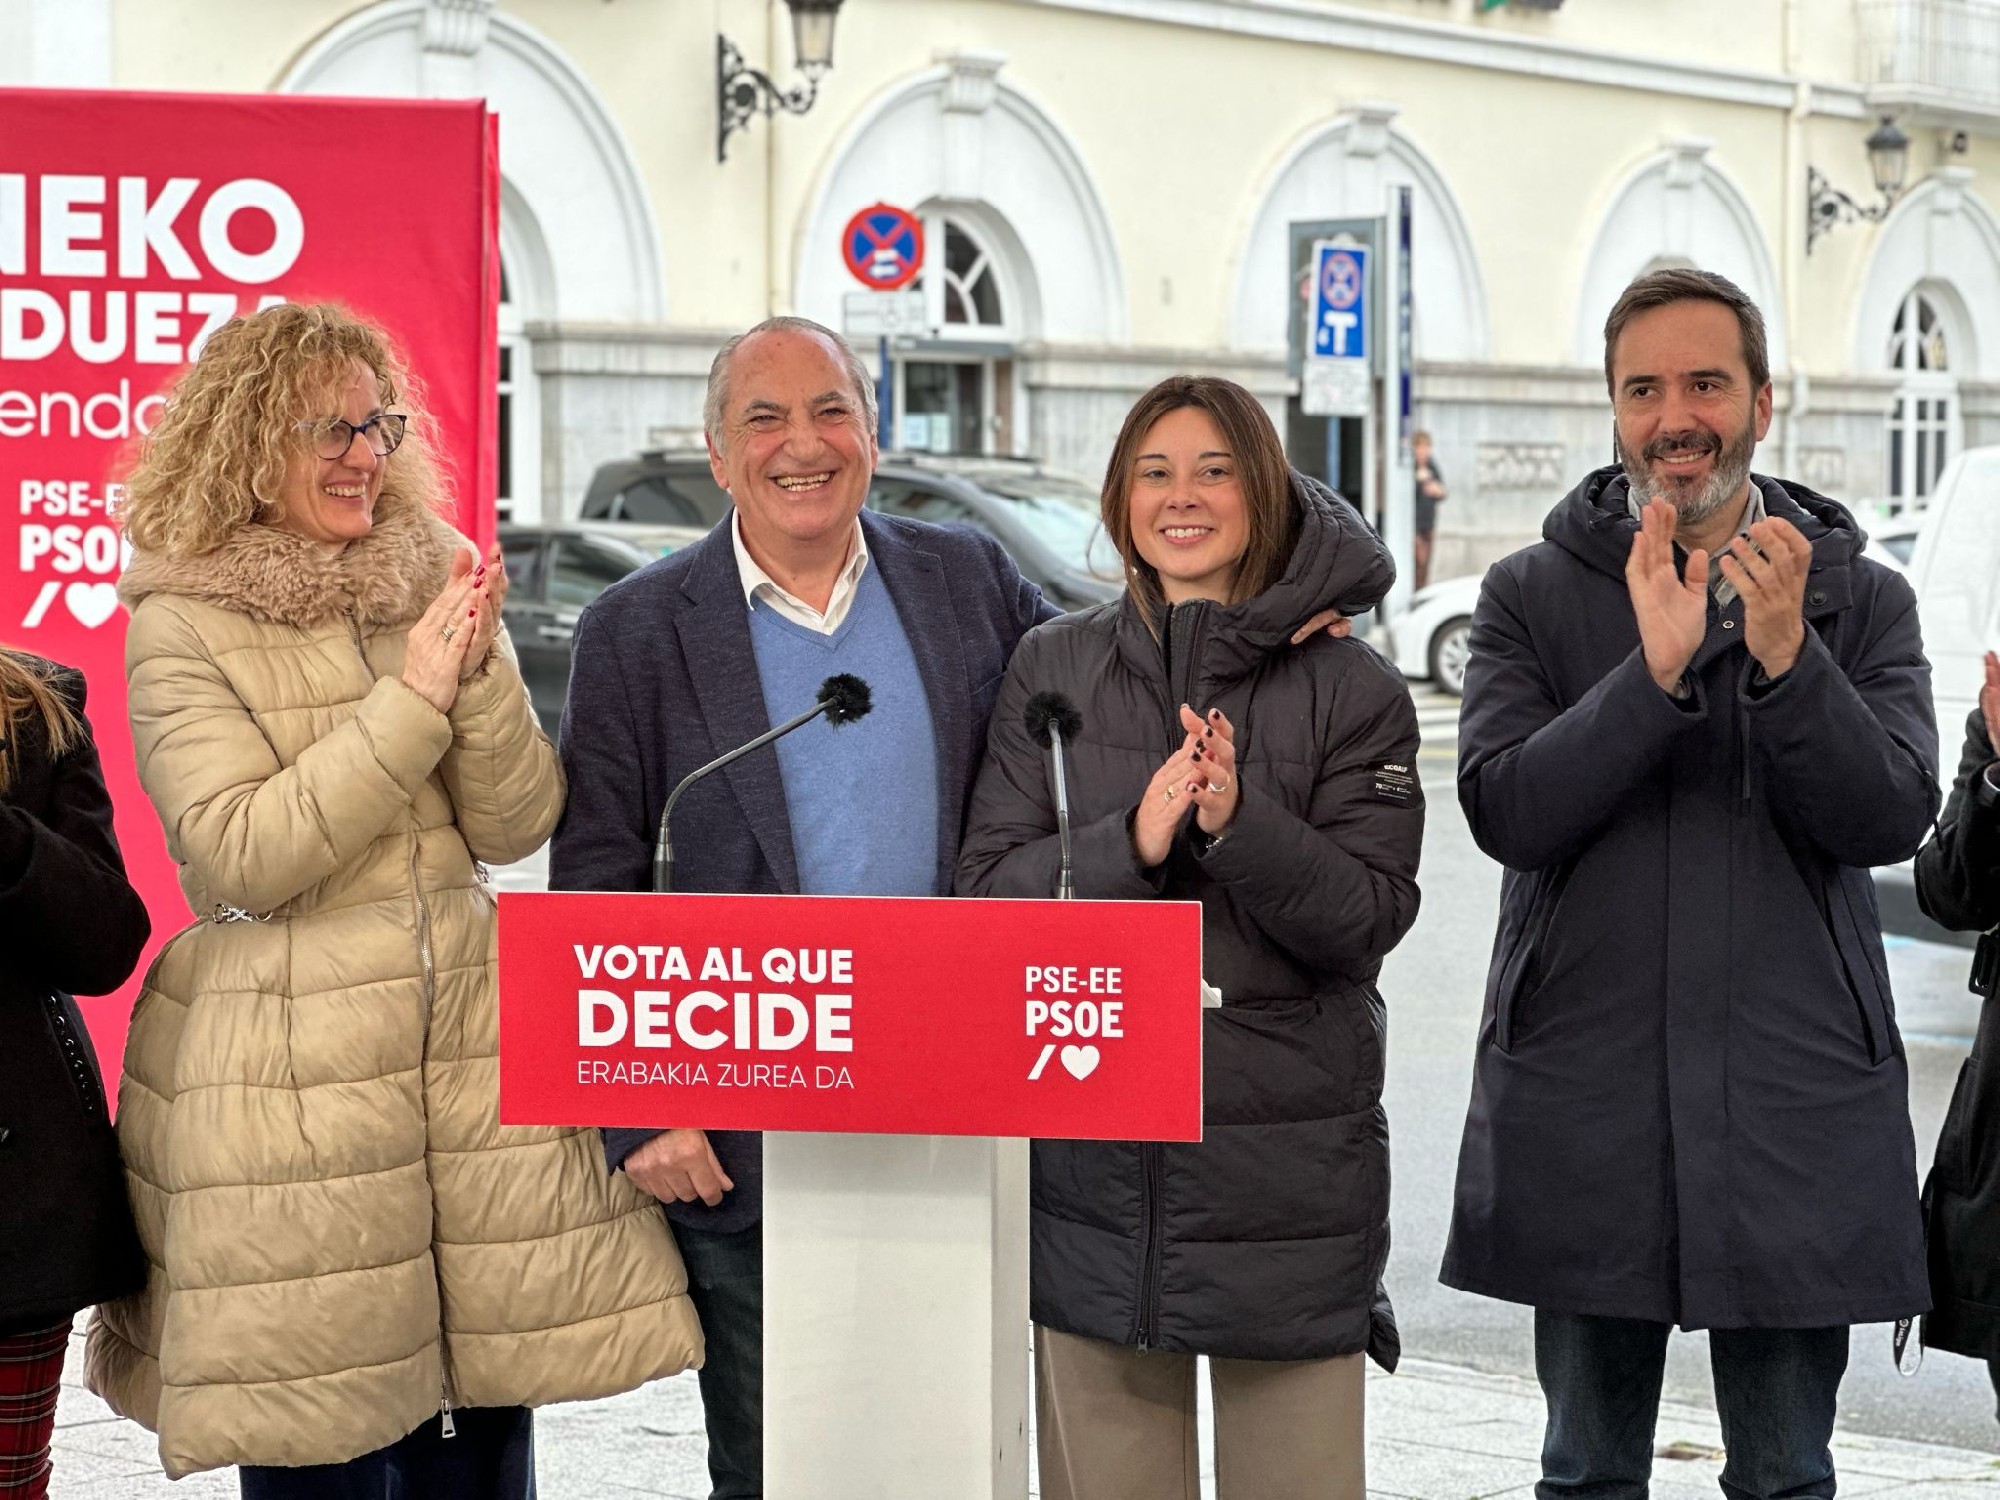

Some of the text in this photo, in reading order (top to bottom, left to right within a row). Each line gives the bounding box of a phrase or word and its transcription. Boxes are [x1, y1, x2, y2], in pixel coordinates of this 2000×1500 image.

[0, 173, 305, 284] EKO
[0, 288, 287, 364] DUEZ
[573, 944, 854, 985] VOTA AL QUE
[1025, 965, 1122, 994] PSE-EE
[578, 989, 853, 1052] DECIDE
[1025, 1000, 1124, 1038] PSOE
[578, 1060, 854, 1089] ERABAKIA ZUREA DA
